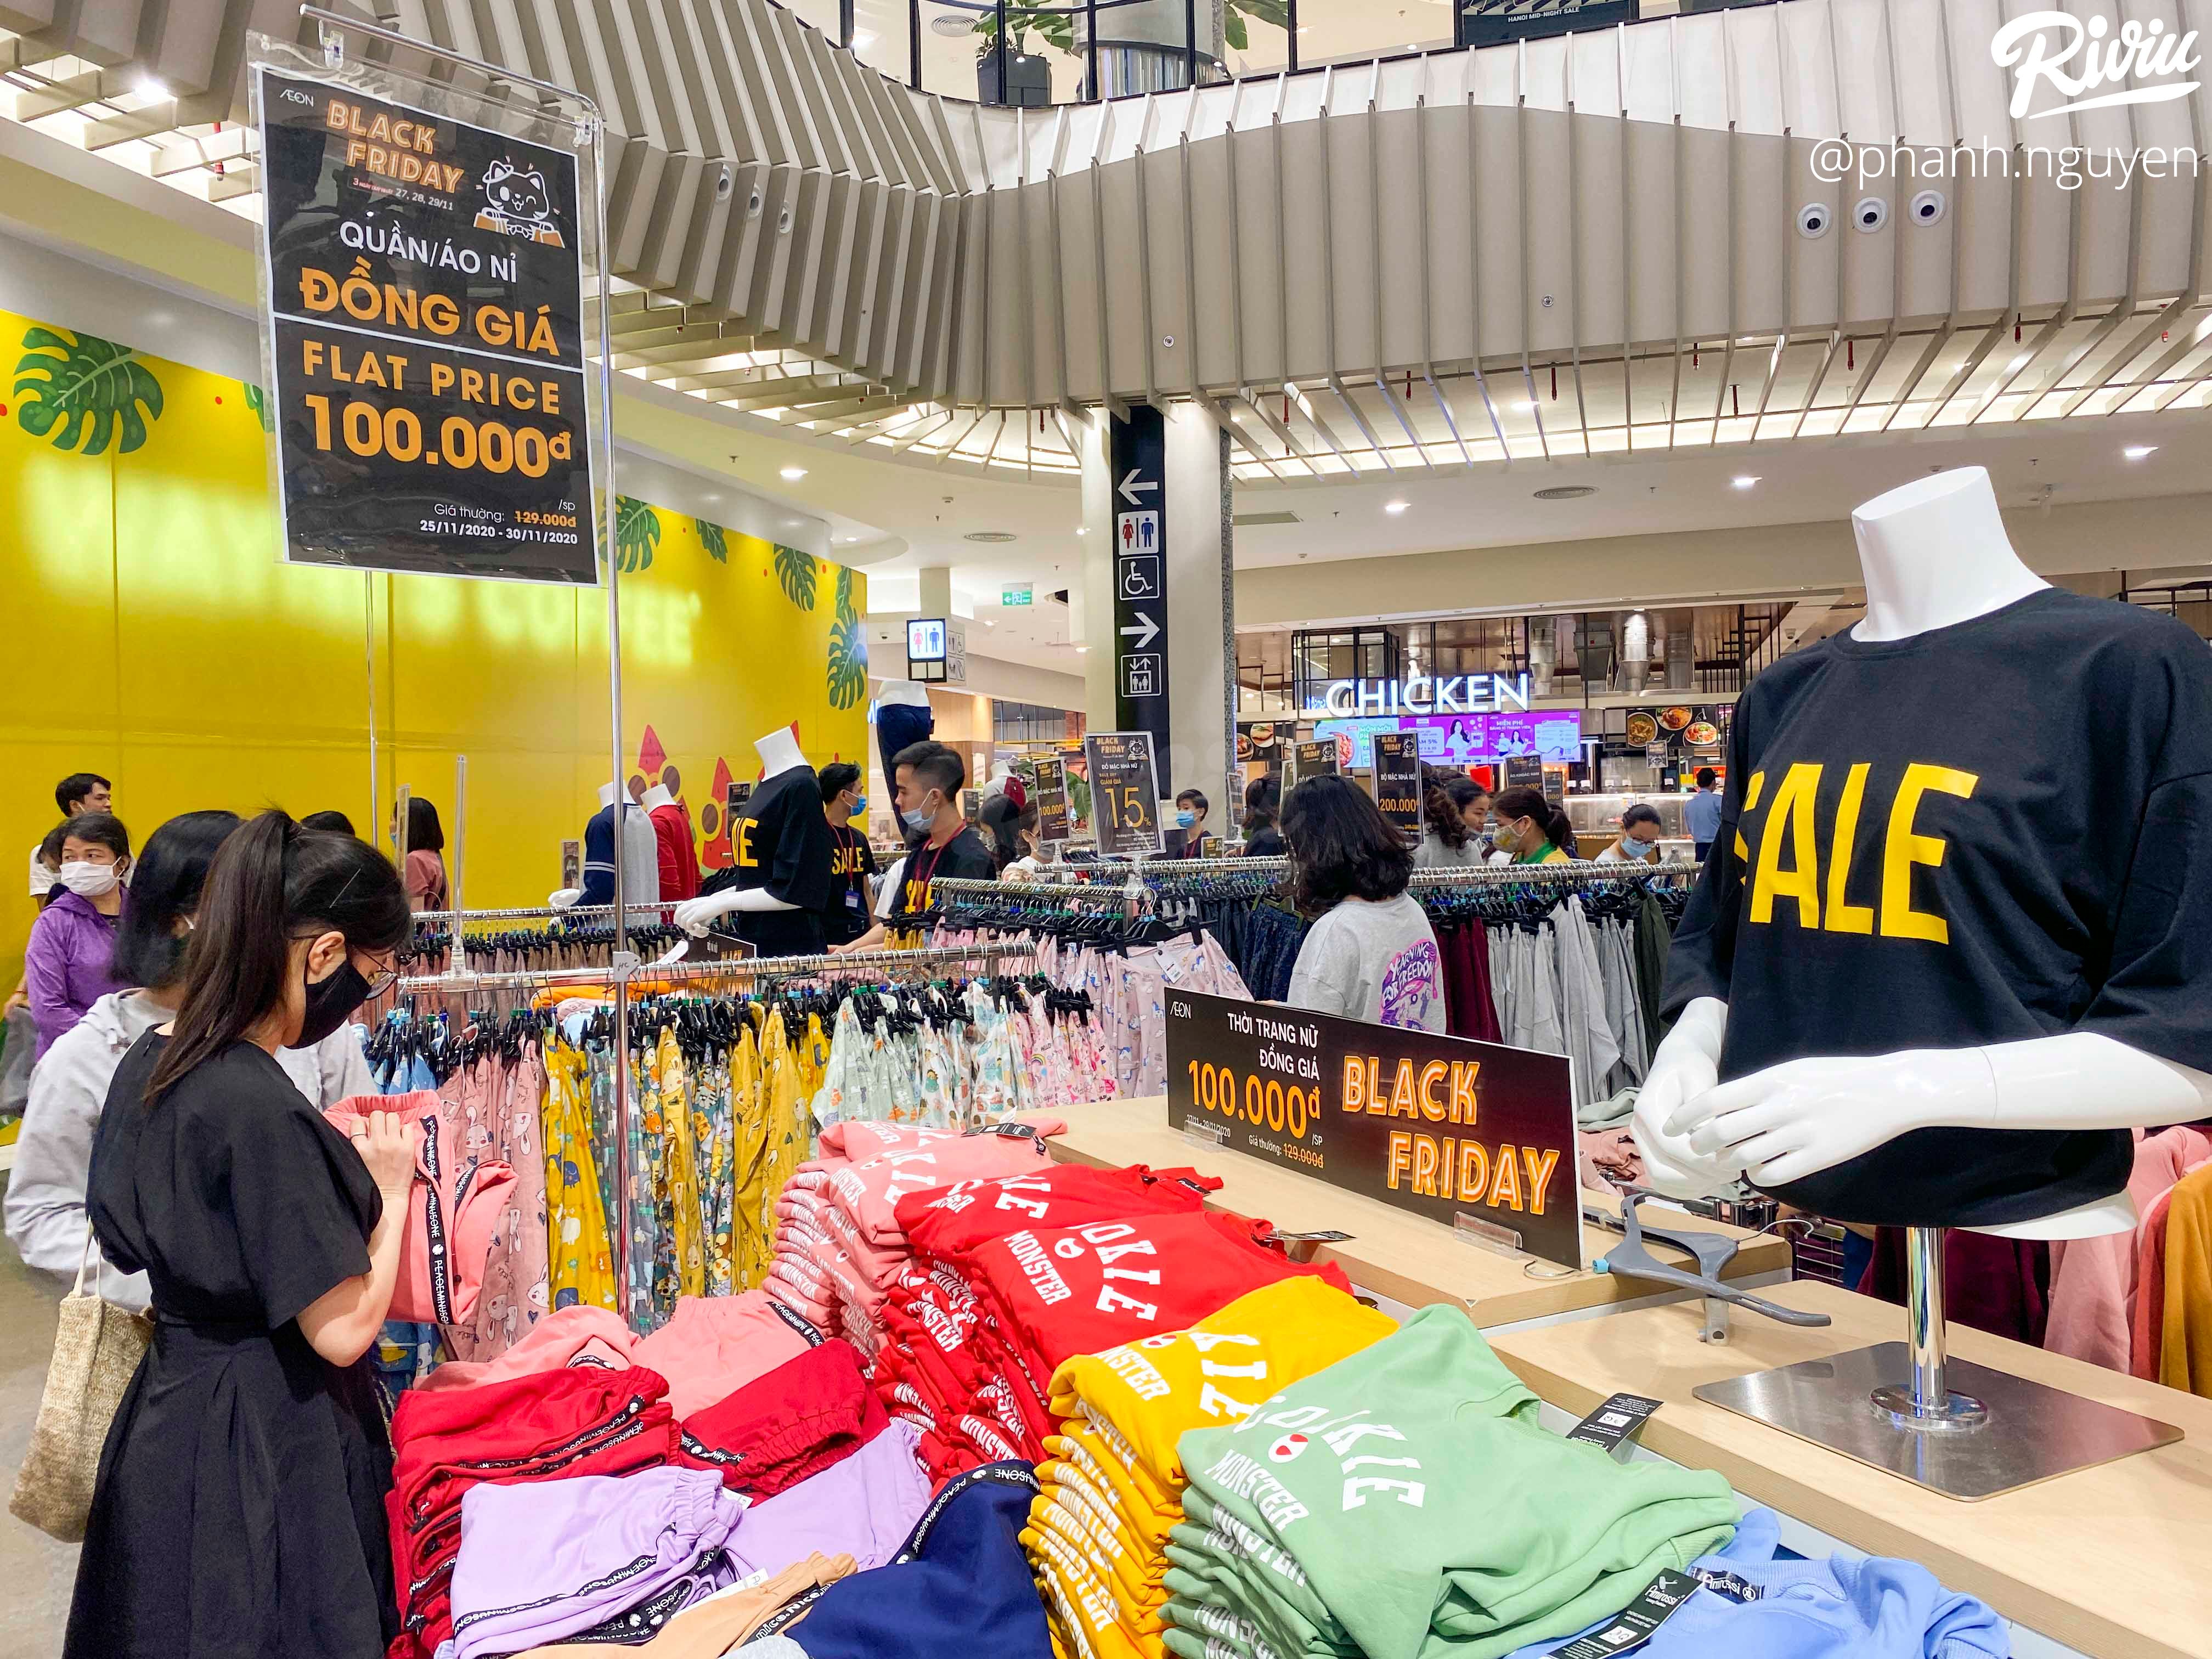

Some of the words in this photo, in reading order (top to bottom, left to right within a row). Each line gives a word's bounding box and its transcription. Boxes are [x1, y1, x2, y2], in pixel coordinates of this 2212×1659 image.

[1529, 9, 1562, 19] MID-NIGHT
[325, 99, 438, 155] BLACK
[345, 141, 465, 194] FRIDAY
[428, 196, 454, 211] 29/11
[299, 256, 460, 336] ĐỒNG
[475, 304, 560, 357] GIÁ
[303, 339, 408, 391] FLAT
[430, 362, 560, 415] PRICE
[304, 394, 571, 479] 100.000đ
[419, 519, 495, 538] 25/11/2020
[506, 528, 578, 545] 30/11/2020
[433, 503, 456, 517] Giá
[458, 507, 505, 524] thường:
[1325, 673, 1529, 718] CHICKEN
[1096, 737, 1119, 745] BLACK
[831, 847, 864, 874] SALE
[1227, 1011, 1253, 1035] THỜI
[1255, 1018, 1296, 1043] TRANG
[1299, 1024, 1319, 1048] NỮ
[1259, 1042, 1295, 1074] ĐỒNG
[1297, 1056, 1321, 1081] GIÁ
[1188, 1059, 1321, 1139] 100.000đ
[1342, 1054, 1481, 1125] BLACK
[1248, 1134, 1259, 1147] Giá
[1283, 1143, 1324, 1169] 129.000đ
[1387, 1130, 1560, 1216] FRIDAY
[1003, 1229, 1073, 1306] MONSTER
[1203, 1448, 1310, 1532] MONSTER
[1644, 1584, 1679, 1606] Amirossi
